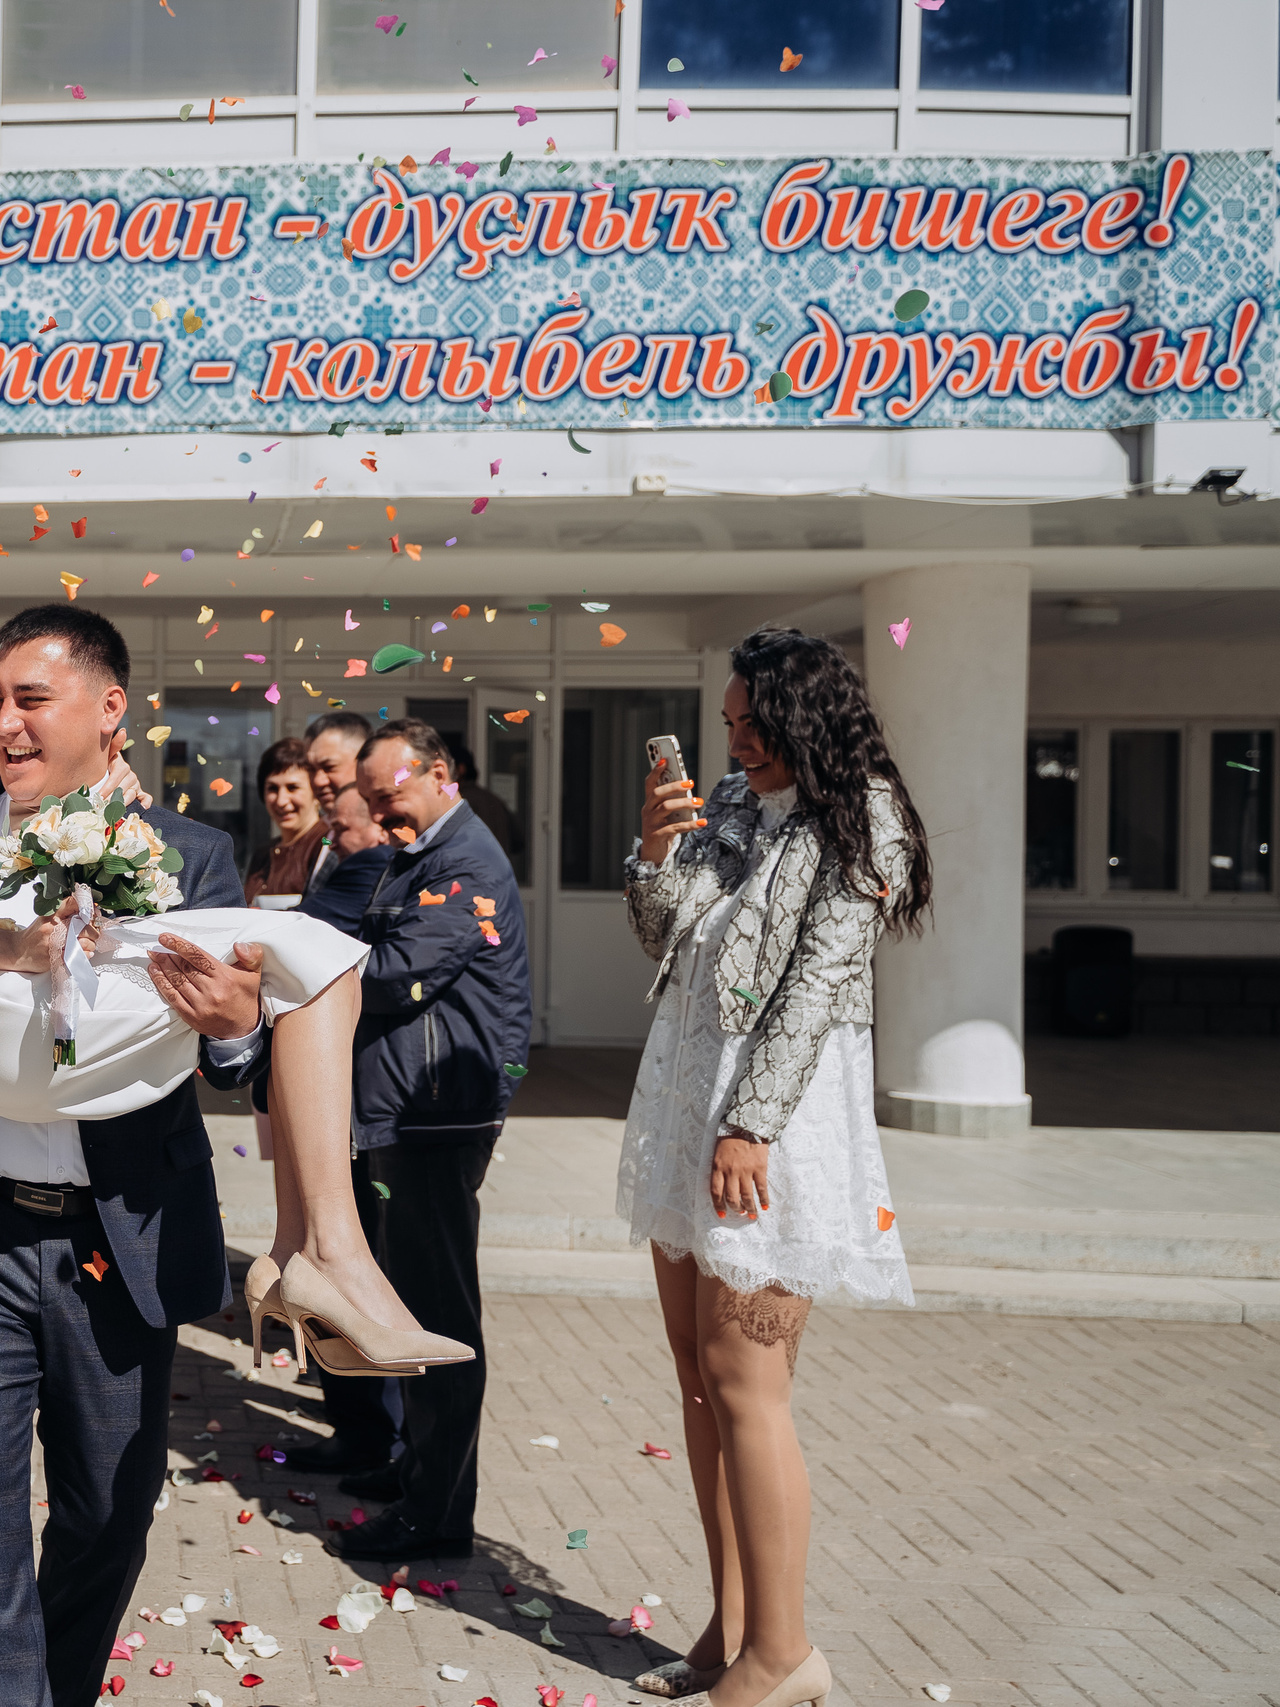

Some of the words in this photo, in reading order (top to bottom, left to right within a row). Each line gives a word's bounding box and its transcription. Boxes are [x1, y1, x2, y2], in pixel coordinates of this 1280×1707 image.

[761, 154, 1191, 255] бишеге!
[263, 306, 751, 403] колыбель
[784, 299, 1257, 421] дружбы!
